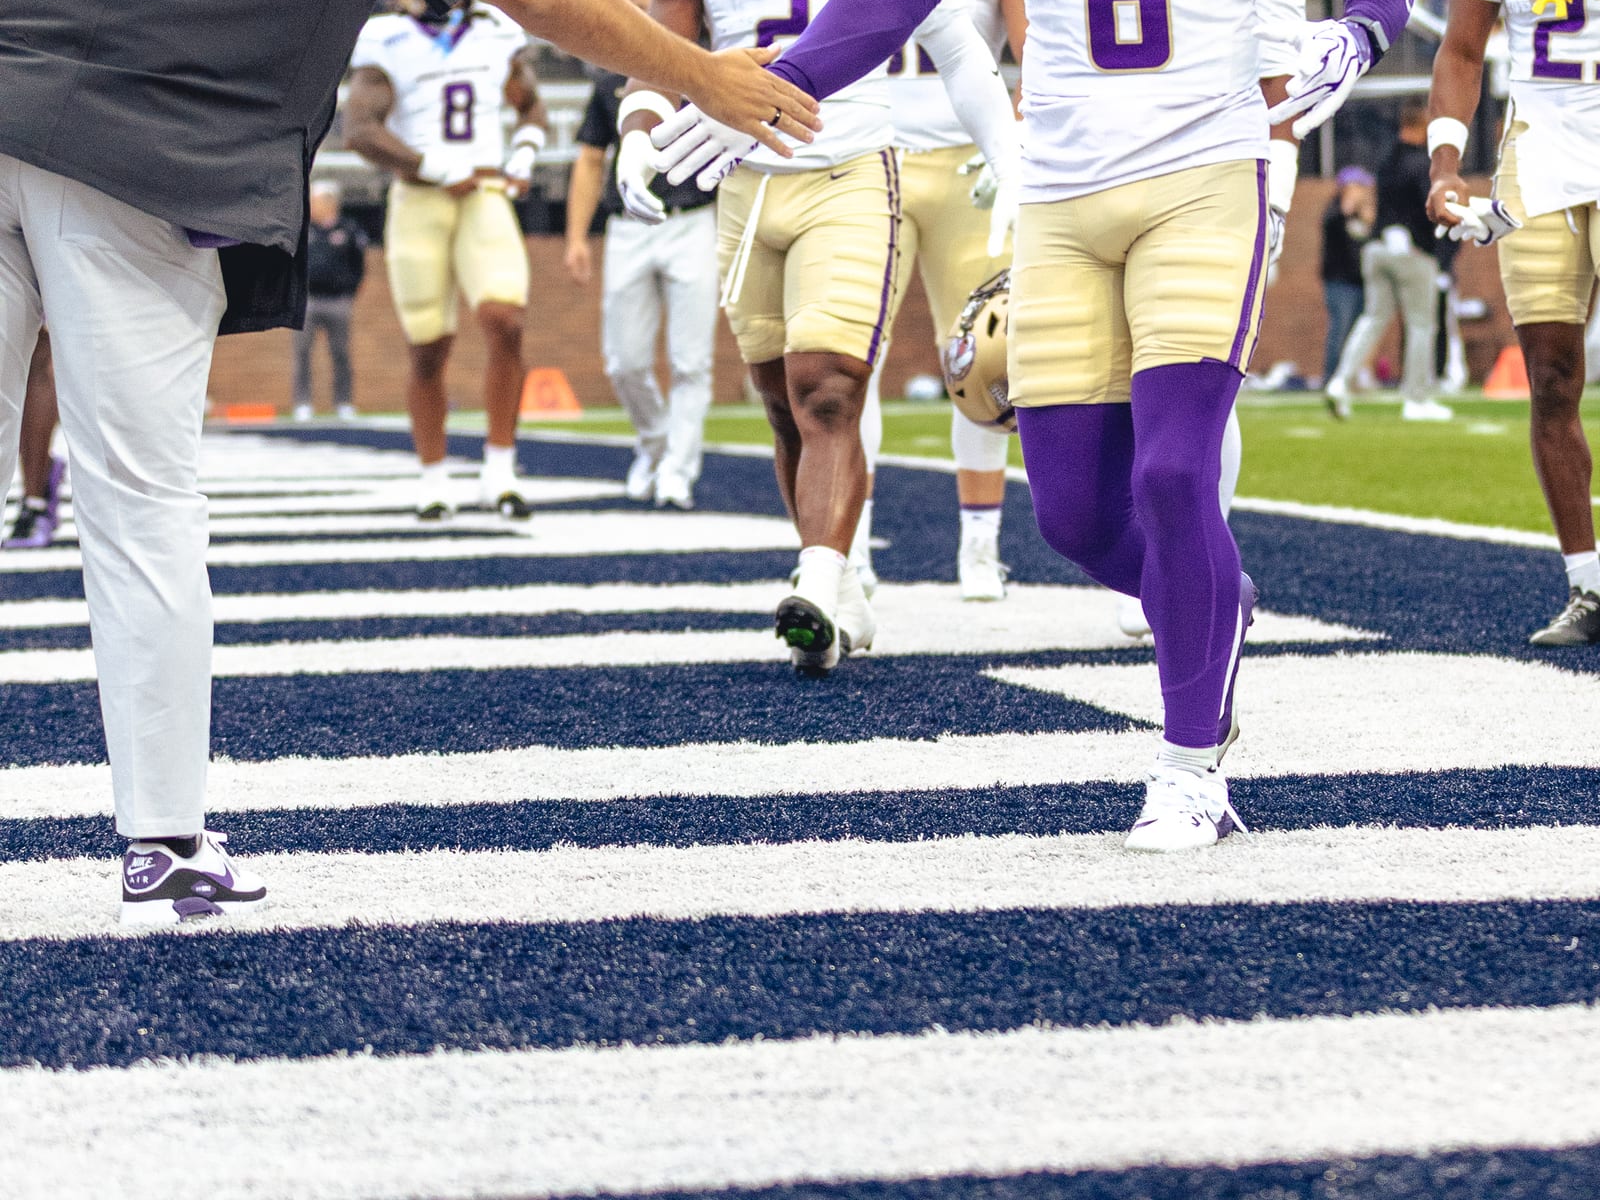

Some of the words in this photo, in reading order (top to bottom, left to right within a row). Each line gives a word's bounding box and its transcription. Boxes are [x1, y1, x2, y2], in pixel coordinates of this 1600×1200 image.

[444, 81, 475, 143] 8
[132, 856, 153, 867] NIKE
[129, 876, 149, 884] AIR
